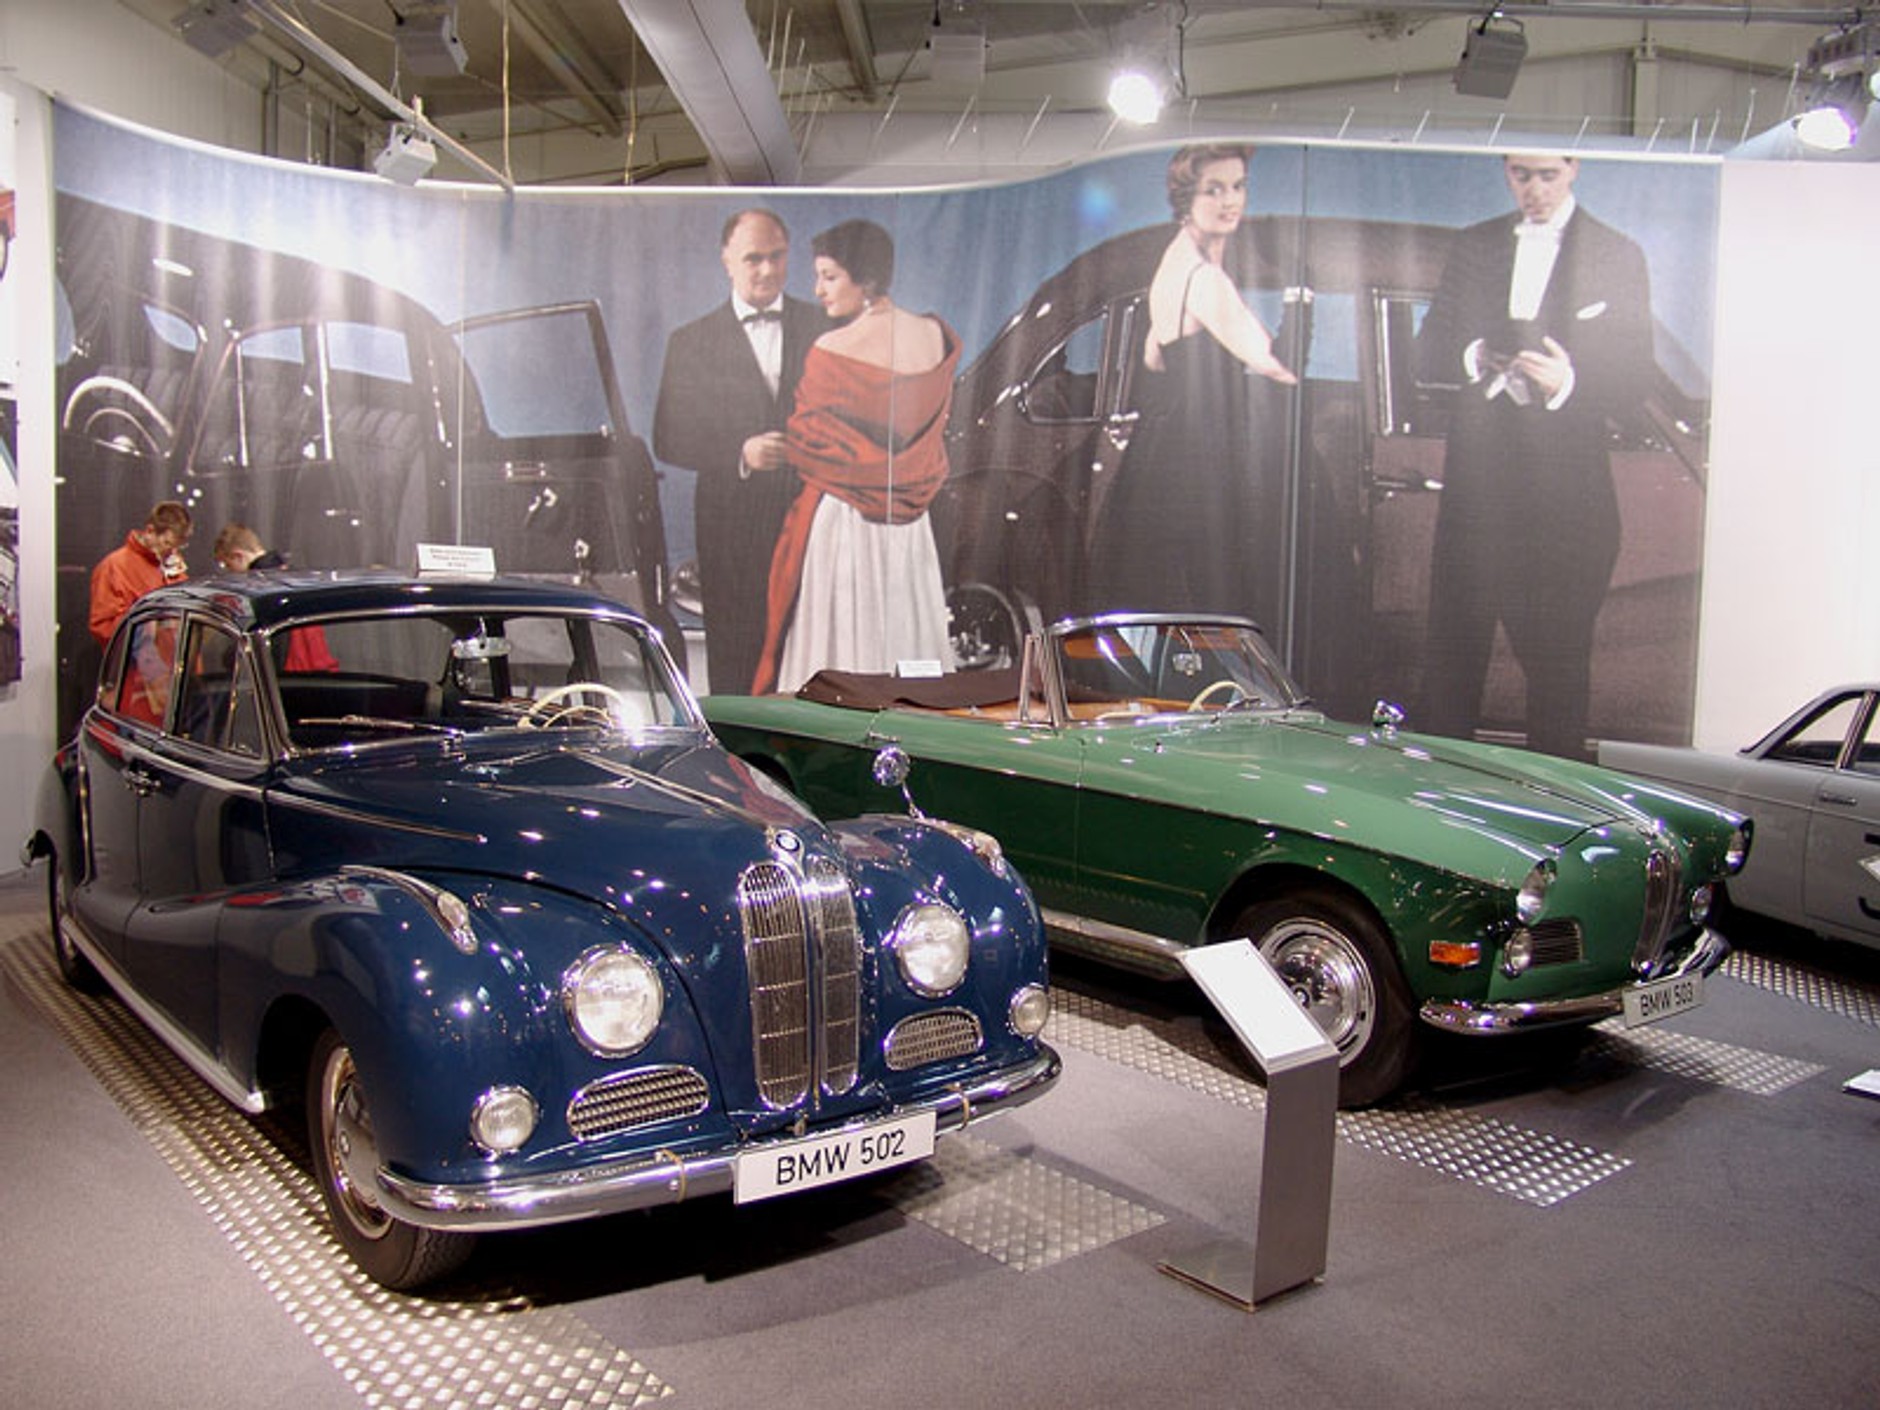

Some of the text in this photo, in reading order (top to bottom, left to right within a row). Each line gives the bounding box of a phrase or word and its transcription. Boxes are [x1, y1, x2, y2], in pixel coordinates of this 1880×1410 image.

[1640, 982, 1693, 1017] BMW 503
[776, 1129, 906, 1186] BMW 502
